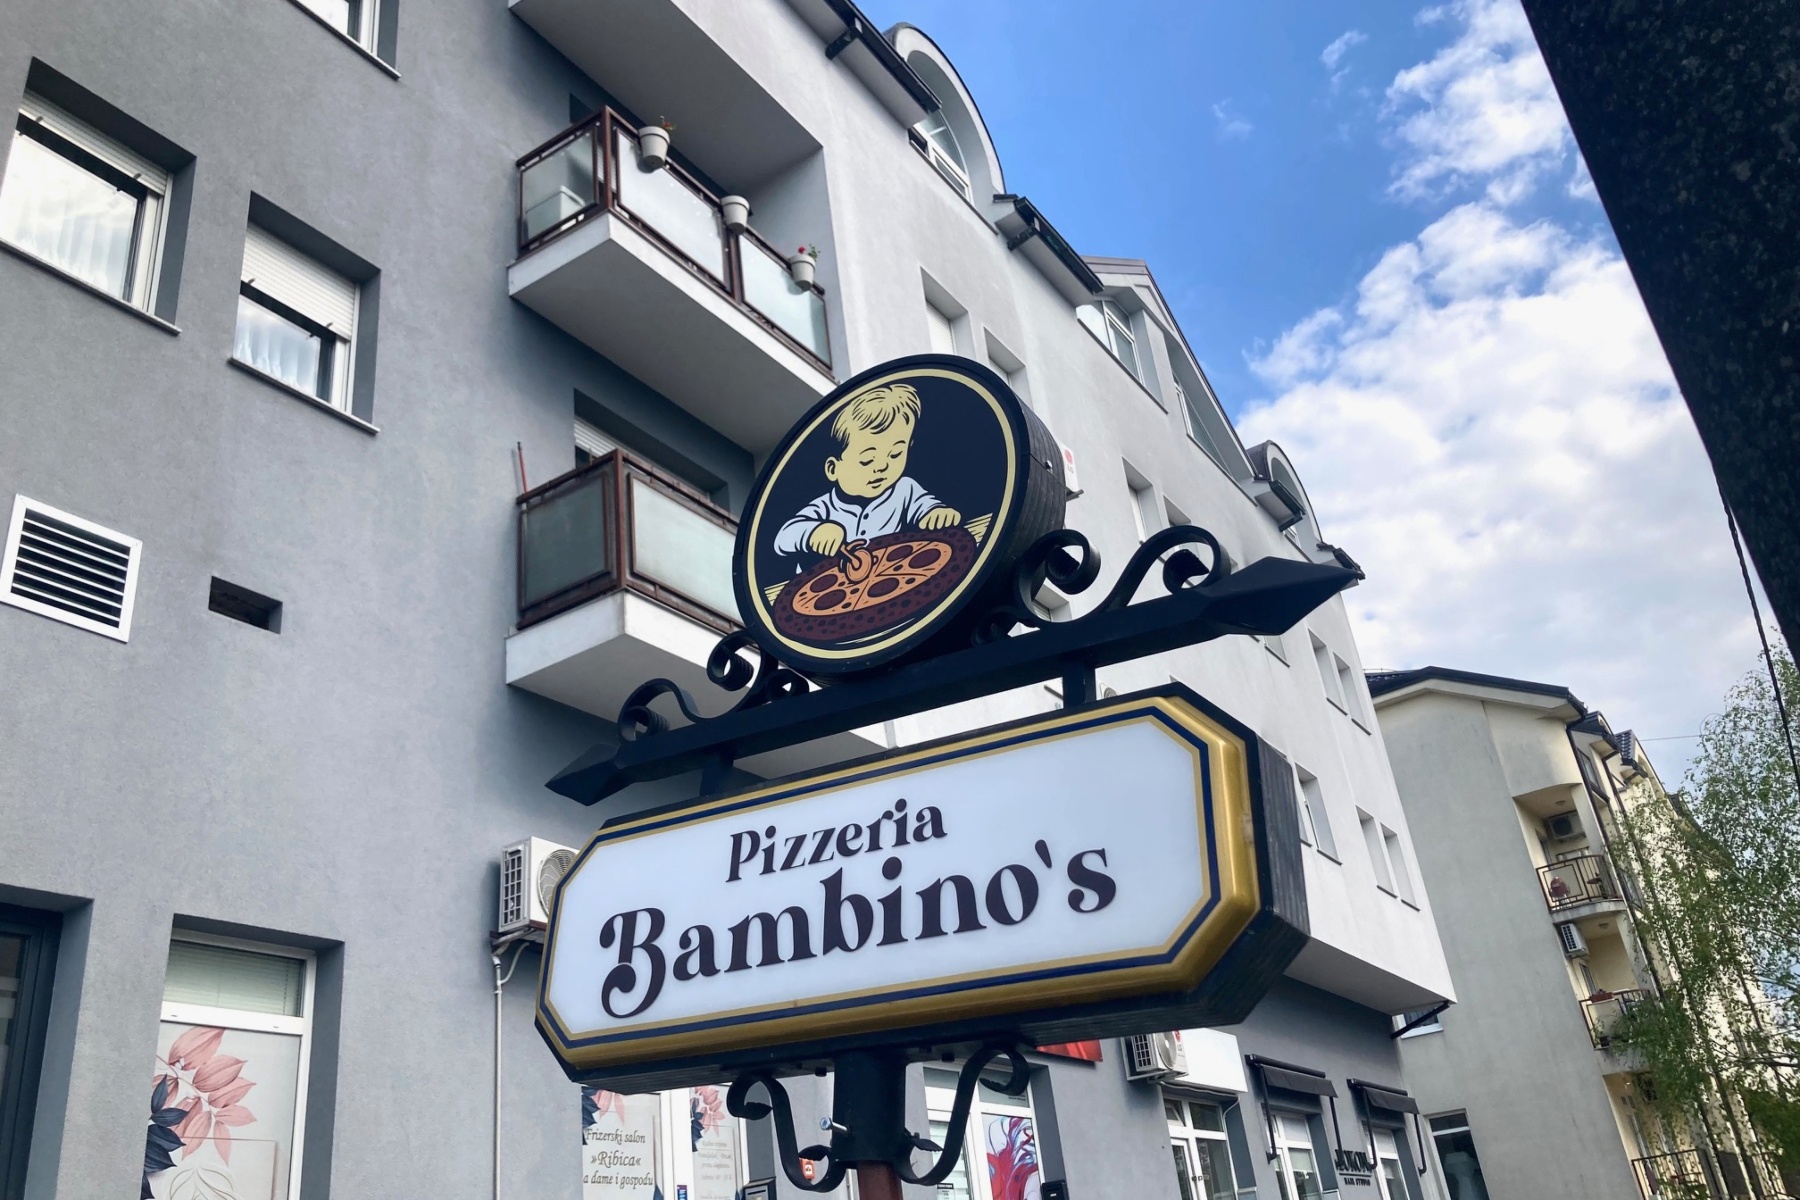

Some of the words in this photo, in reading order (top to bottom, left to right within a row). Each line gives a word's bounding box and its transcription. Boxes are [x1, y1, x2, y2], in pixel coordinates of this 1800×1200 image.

[725, 798, 948, 883] Pizzeria
[598, 838, 1117, 1019] Bambino's
[585, 1128, 623, 1146] Frizerski
[624, 1130, 646, 1144] salon
[583, 1174, 589, 1184] a
[590, 1170, 614, 1185] dame
[615, 1172, 620, 1185] i
[620, 1172, 654, 1190] gospodu
